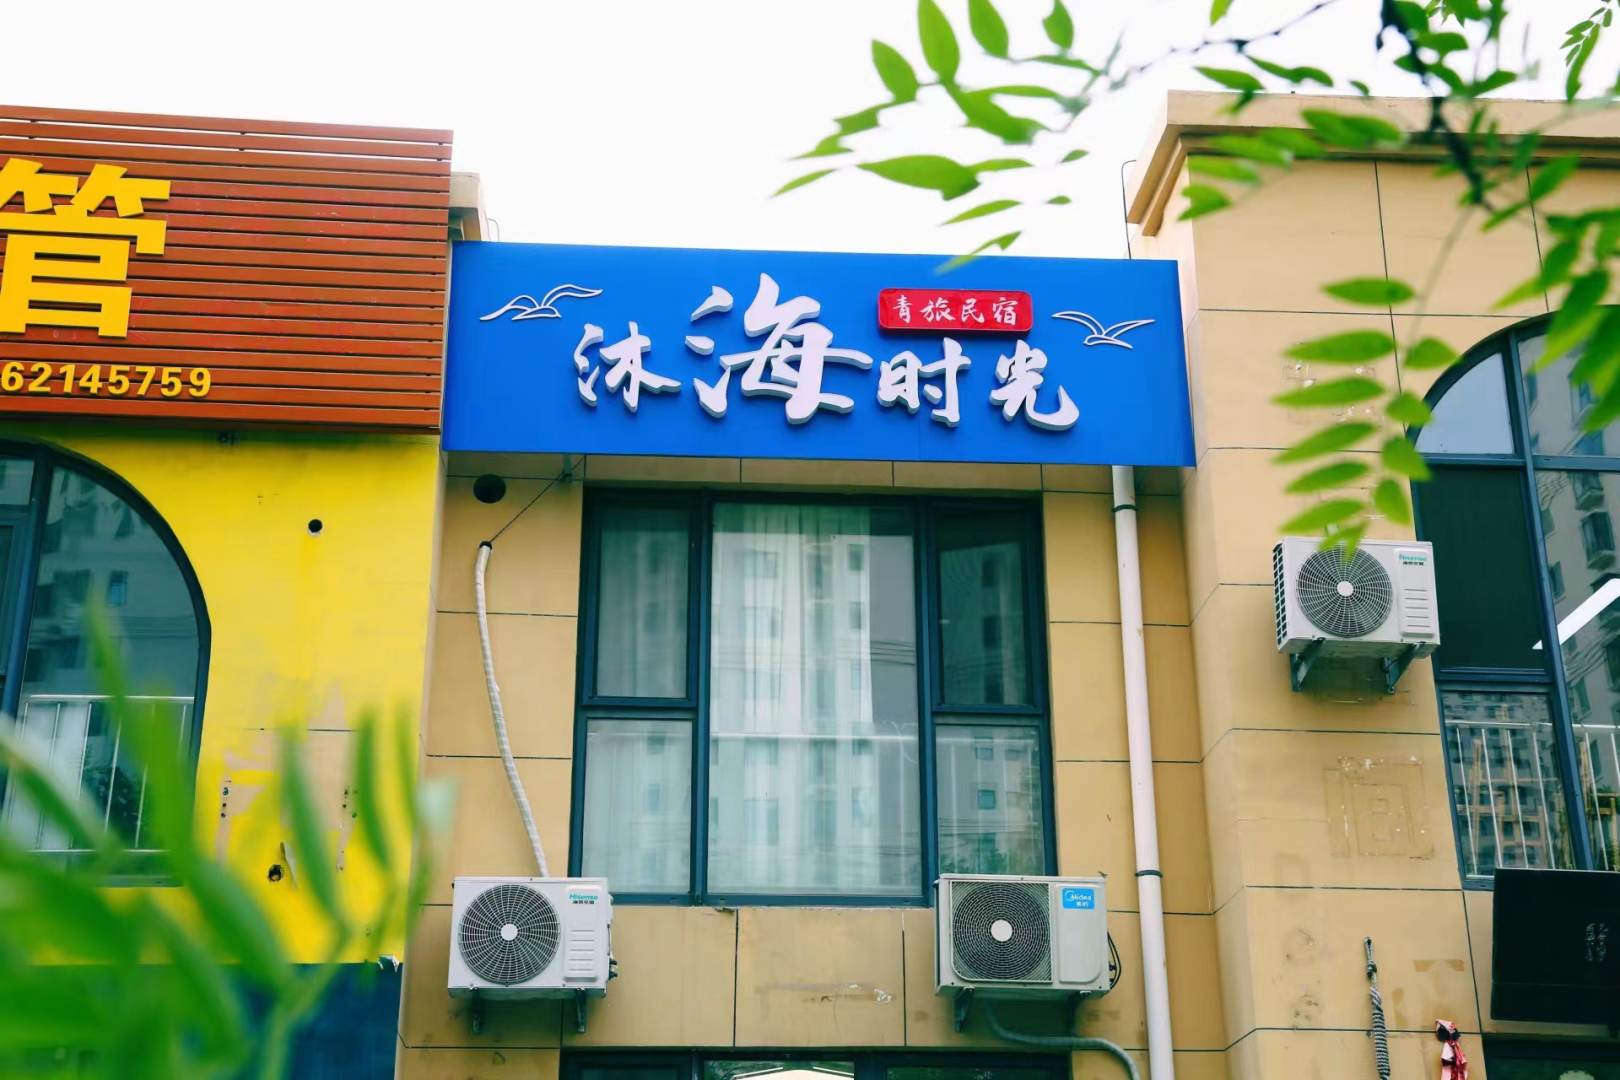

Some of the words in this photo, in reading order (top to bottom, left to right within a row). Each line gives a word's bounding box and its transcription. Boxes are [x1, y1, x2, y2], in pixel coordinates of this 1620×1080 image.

[0, 157, 171, 338] 管
[573, 272, 1080, 431] 沐海时光
[892, 294, 1019, 326] 青旅民宿
[1, 361, 211, 397] 62145759
